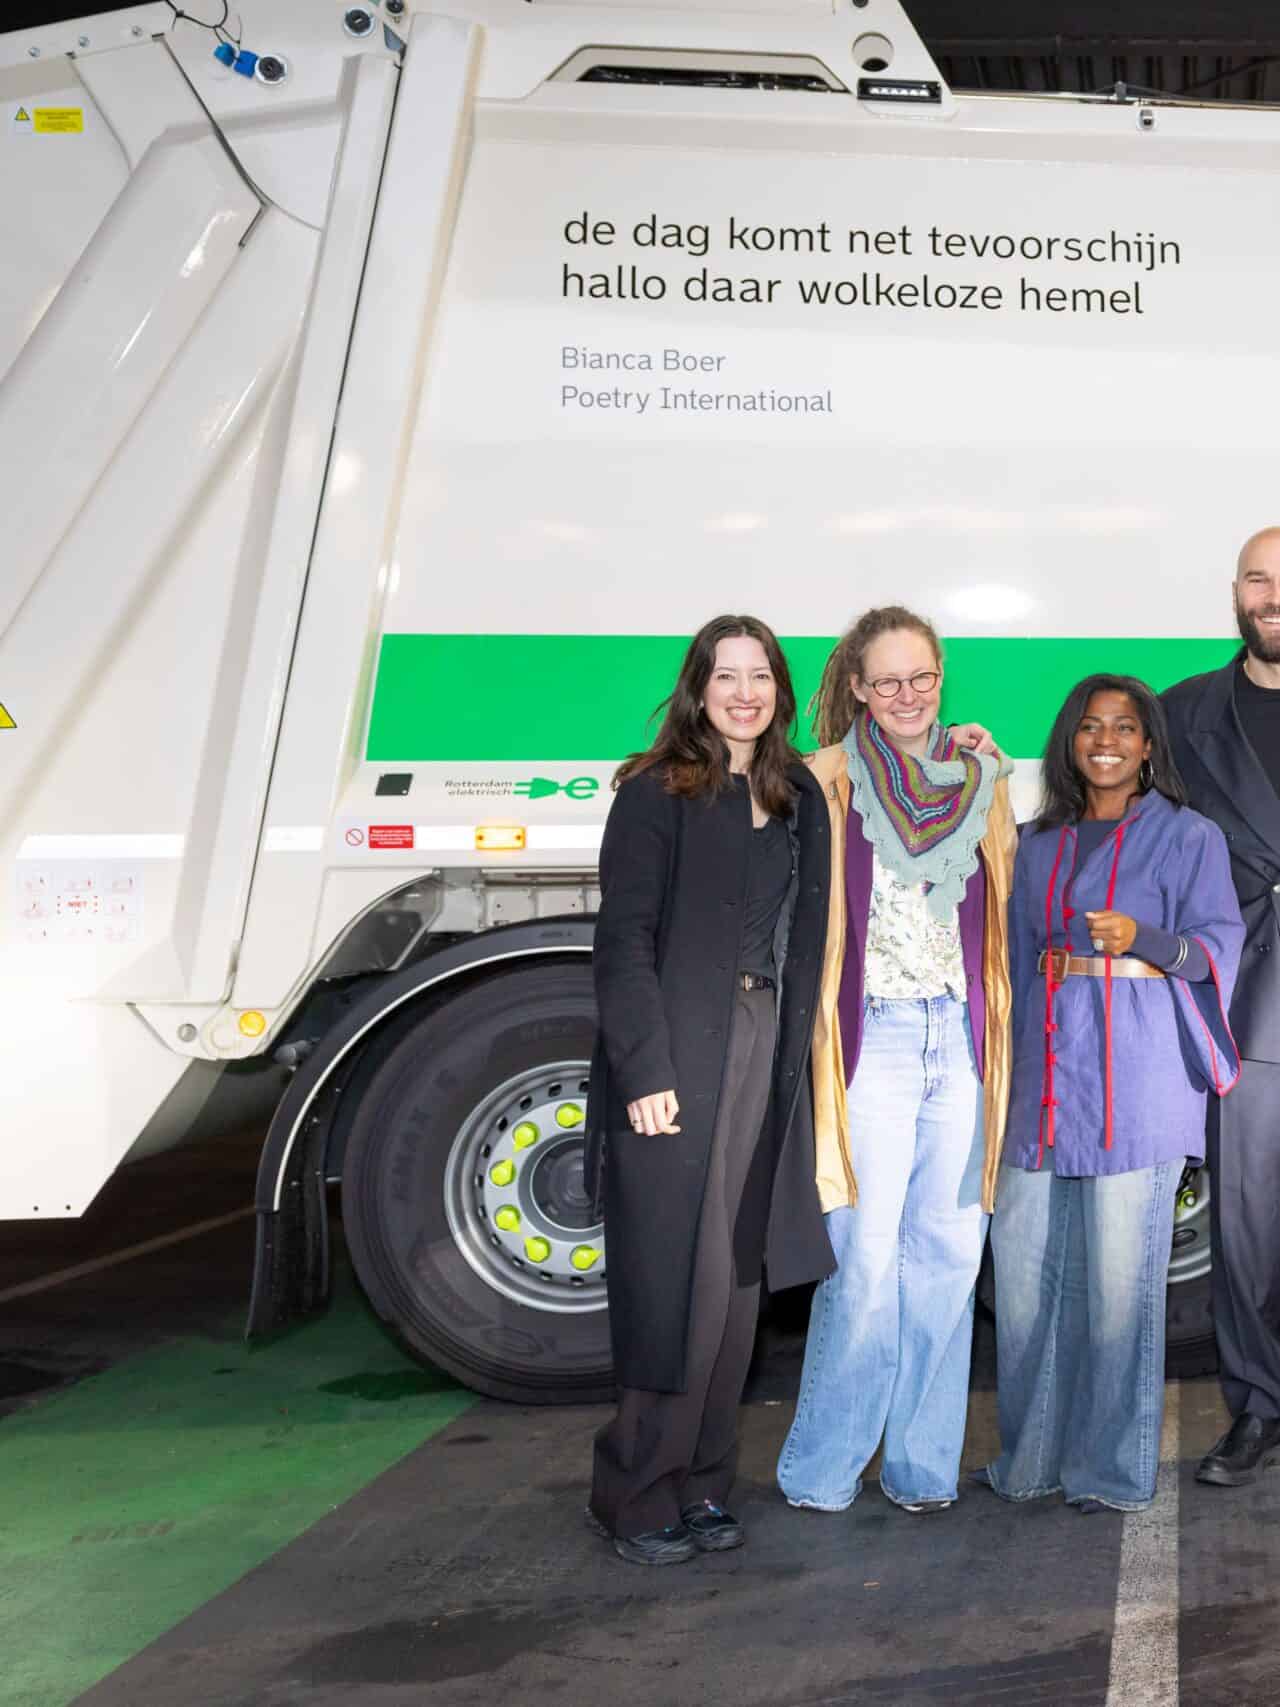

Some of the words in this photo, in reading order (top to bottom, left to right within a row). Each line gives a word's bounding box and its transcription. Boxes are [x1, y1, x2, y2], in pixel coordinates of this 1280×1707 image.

[563, 210, 616, 246] de
[632, 213, 710, 257] dag
[729, 216, 831, 253] komt
[849, 225, 913, 256] net
[927, 226, 1180, 271] tevoorschijn
[562, 263, 667, 300] hallo
[683, 267, 782, 303] daar
[798, 272, 1003, 310] wolkeloze
[1020, 277, 1144, 314] hemel
[561, 346, 653, 371] Bianca
[663, 349, 726, 372] Boer
[561, 384, 650, 414] Poetry
[659, 387, 833, 413] International
[444, 779, 513, 788] Rotterdam
[447, 787, 512, 797] elektrisch
